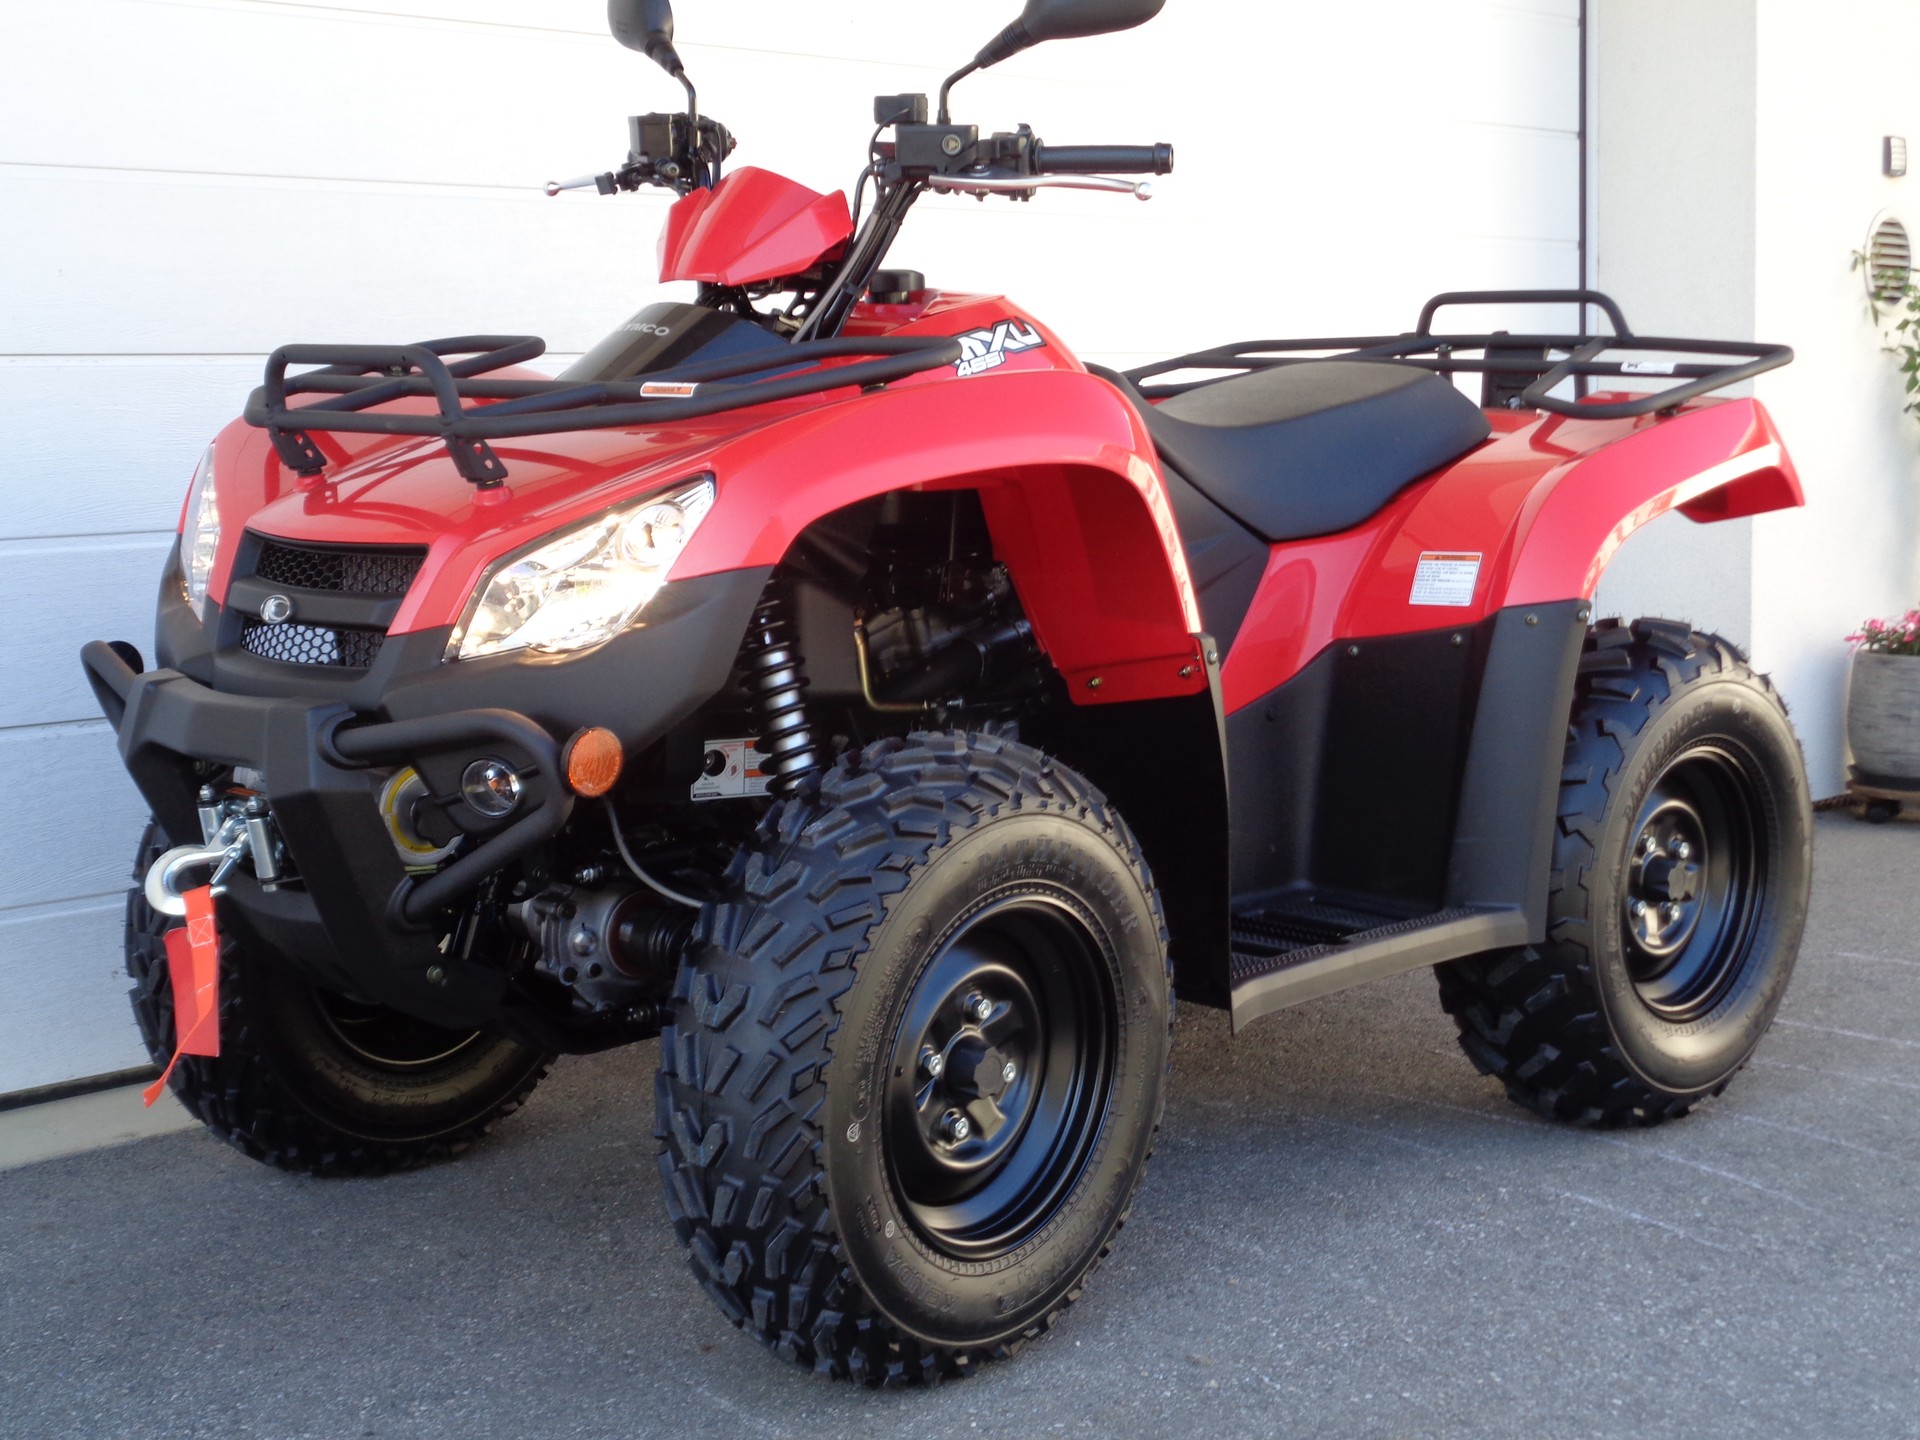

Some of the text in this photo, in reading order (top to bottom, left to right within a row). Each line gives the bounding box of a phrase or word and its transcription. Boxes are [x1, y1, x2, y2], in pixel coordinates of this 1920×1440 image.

[955, 320, 1043, 364] MXU
[976, 838, 1138, 935] PATHFINDER
[885, 1245, 960, 1314] KENDA
